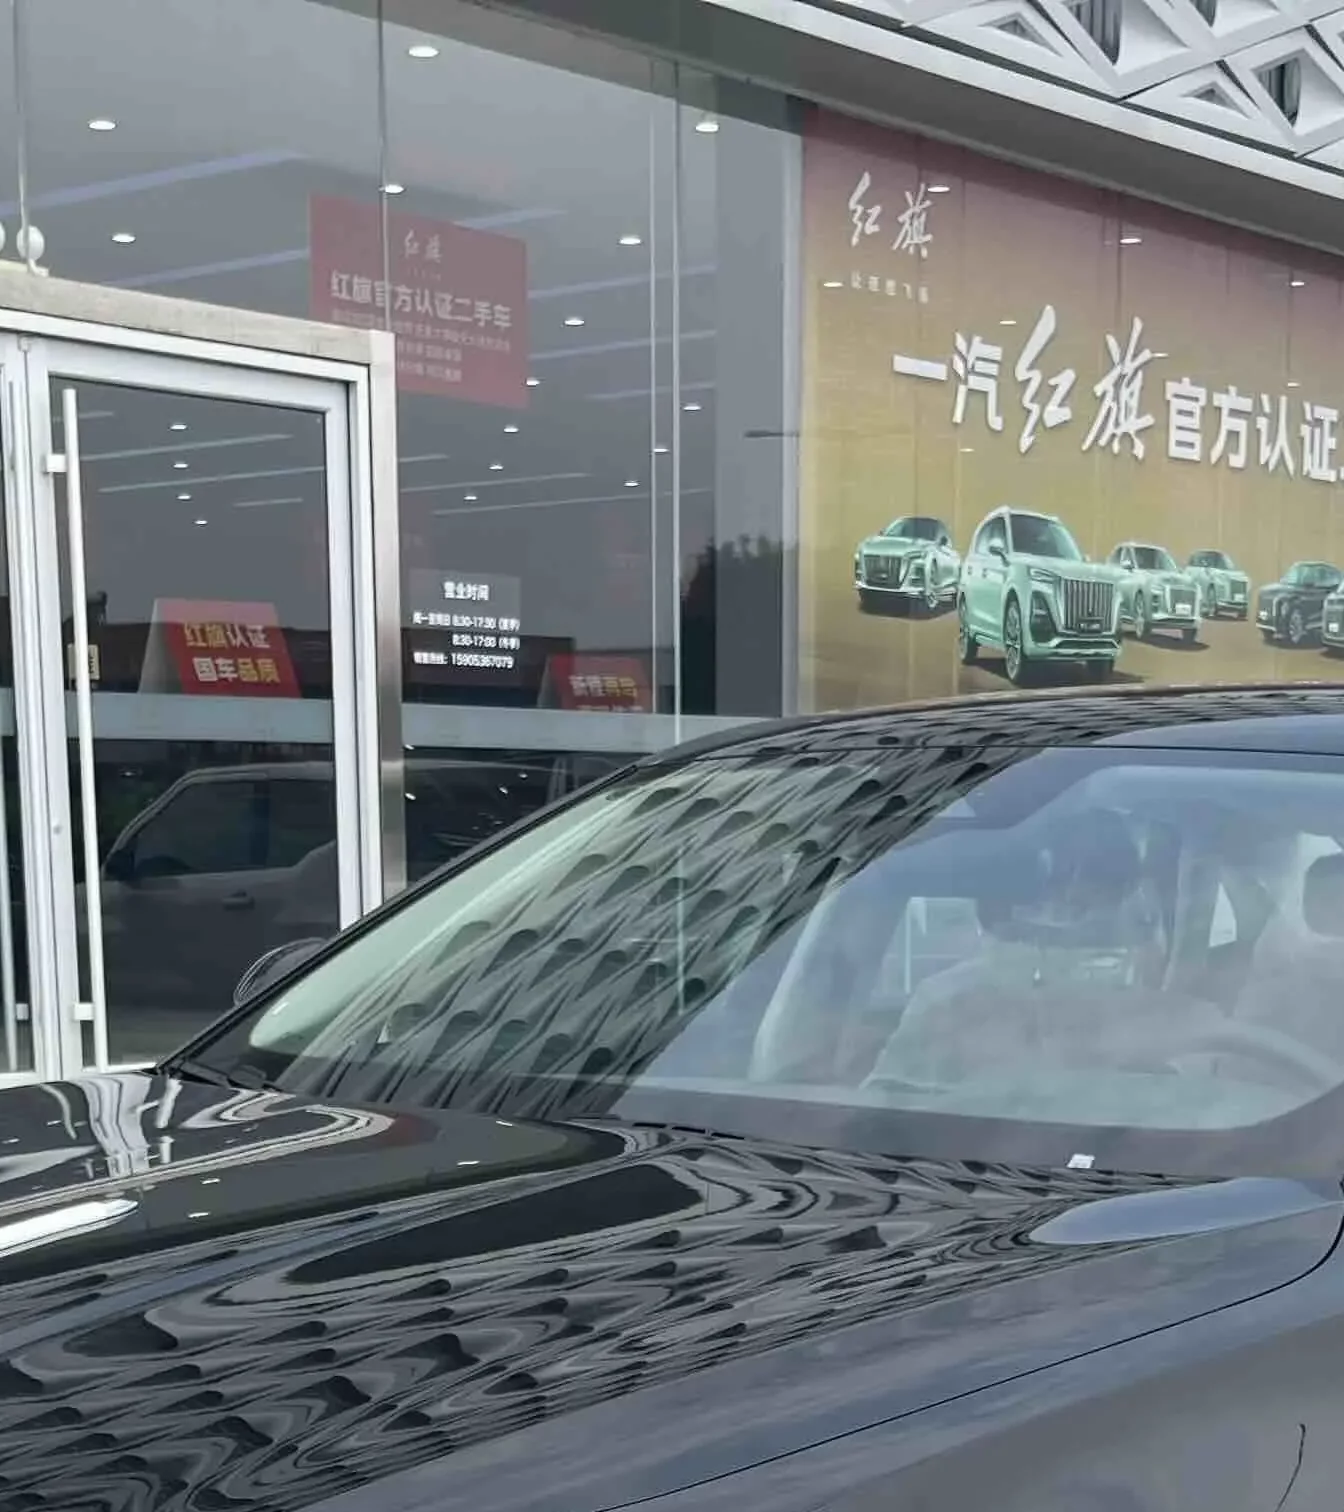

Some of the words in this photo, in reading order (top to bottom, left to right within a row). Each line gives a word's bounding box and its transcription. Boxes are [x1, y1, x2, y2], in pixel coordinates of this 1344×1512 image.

[848, 171, 933, 259] 红旗
[184, 622, 270, 648] 红旗认证
[193, 657, 281, 683] 国车品质
